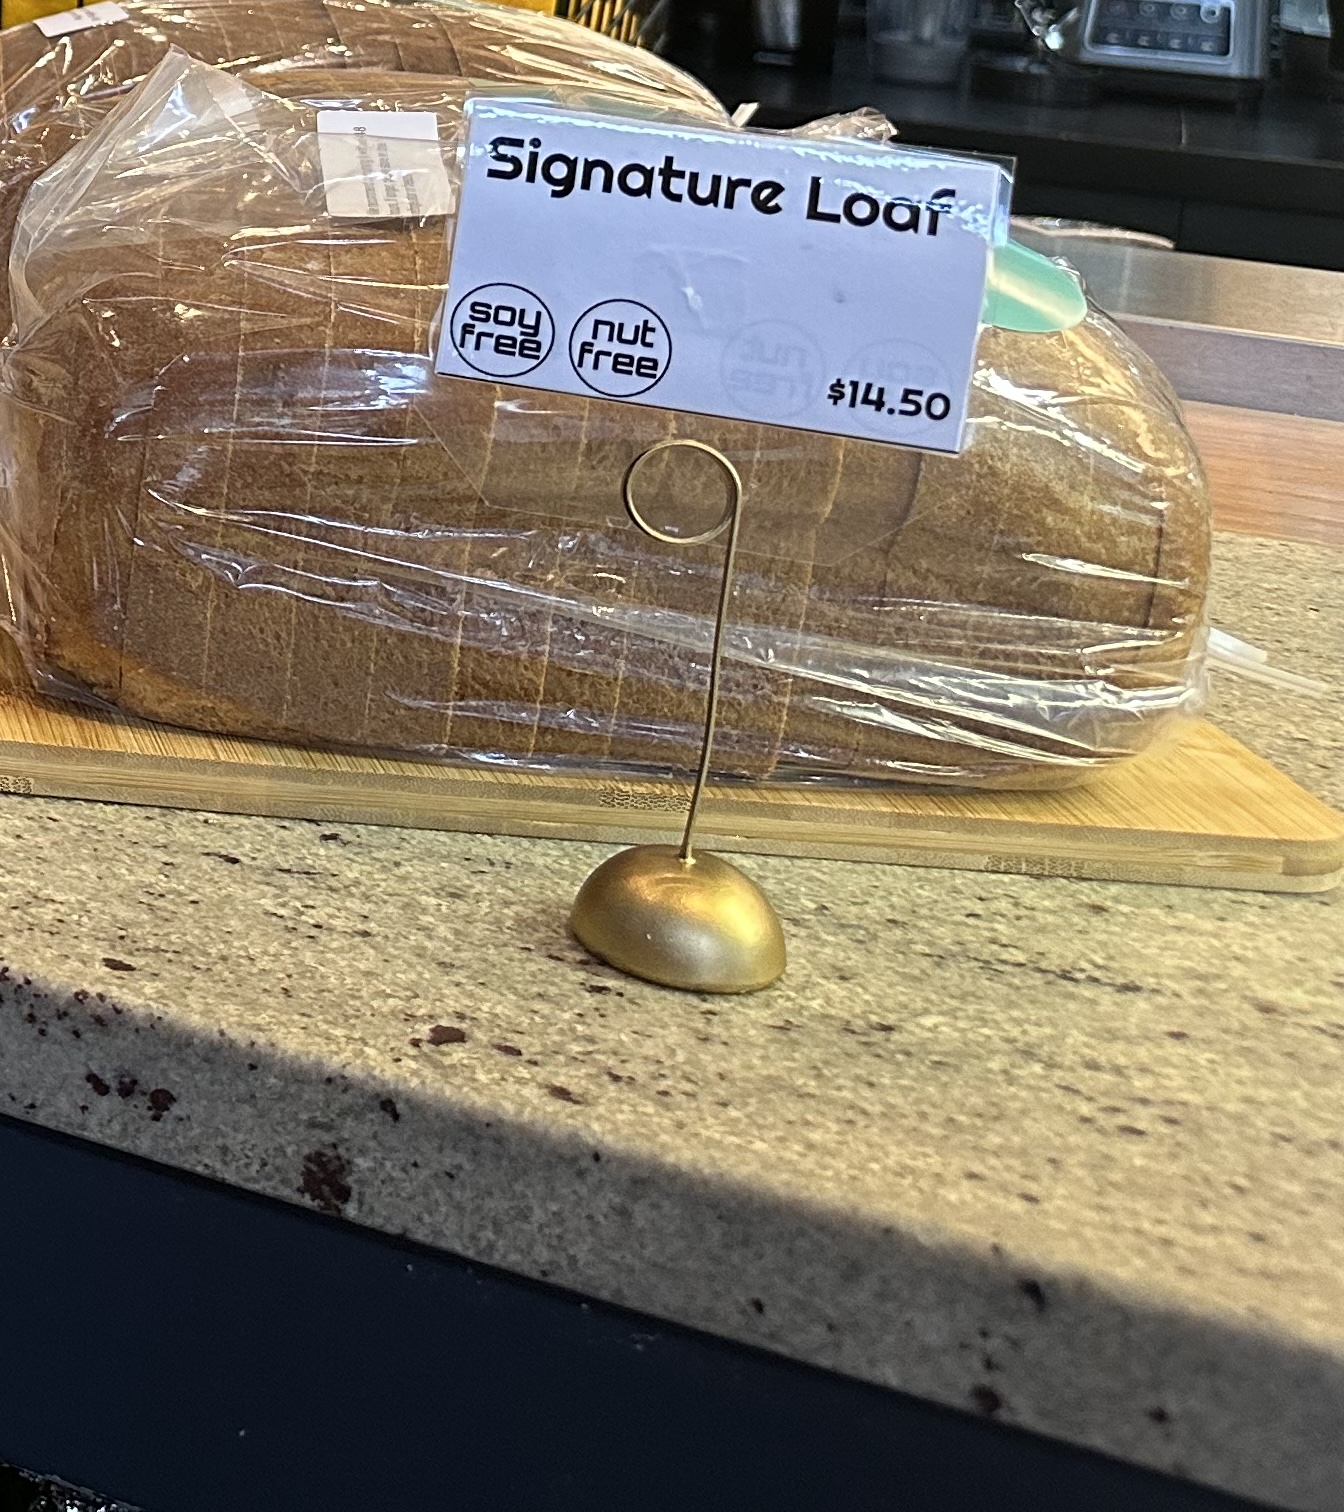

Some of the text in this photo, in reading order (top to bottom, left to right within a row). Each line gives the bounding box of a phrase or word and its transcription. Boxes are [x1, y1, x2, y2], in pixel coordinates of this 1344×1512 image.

[487, 136, 786, 216] Signature
[806, 176, 957, 237] Loaf
[468, 301, 542, 338] soy
[591, 319, 657, 348] nut
[459, 323, 542, 361] free
[577, 341, 659, 379] free
[827, 378, 951, 421] $14.50
